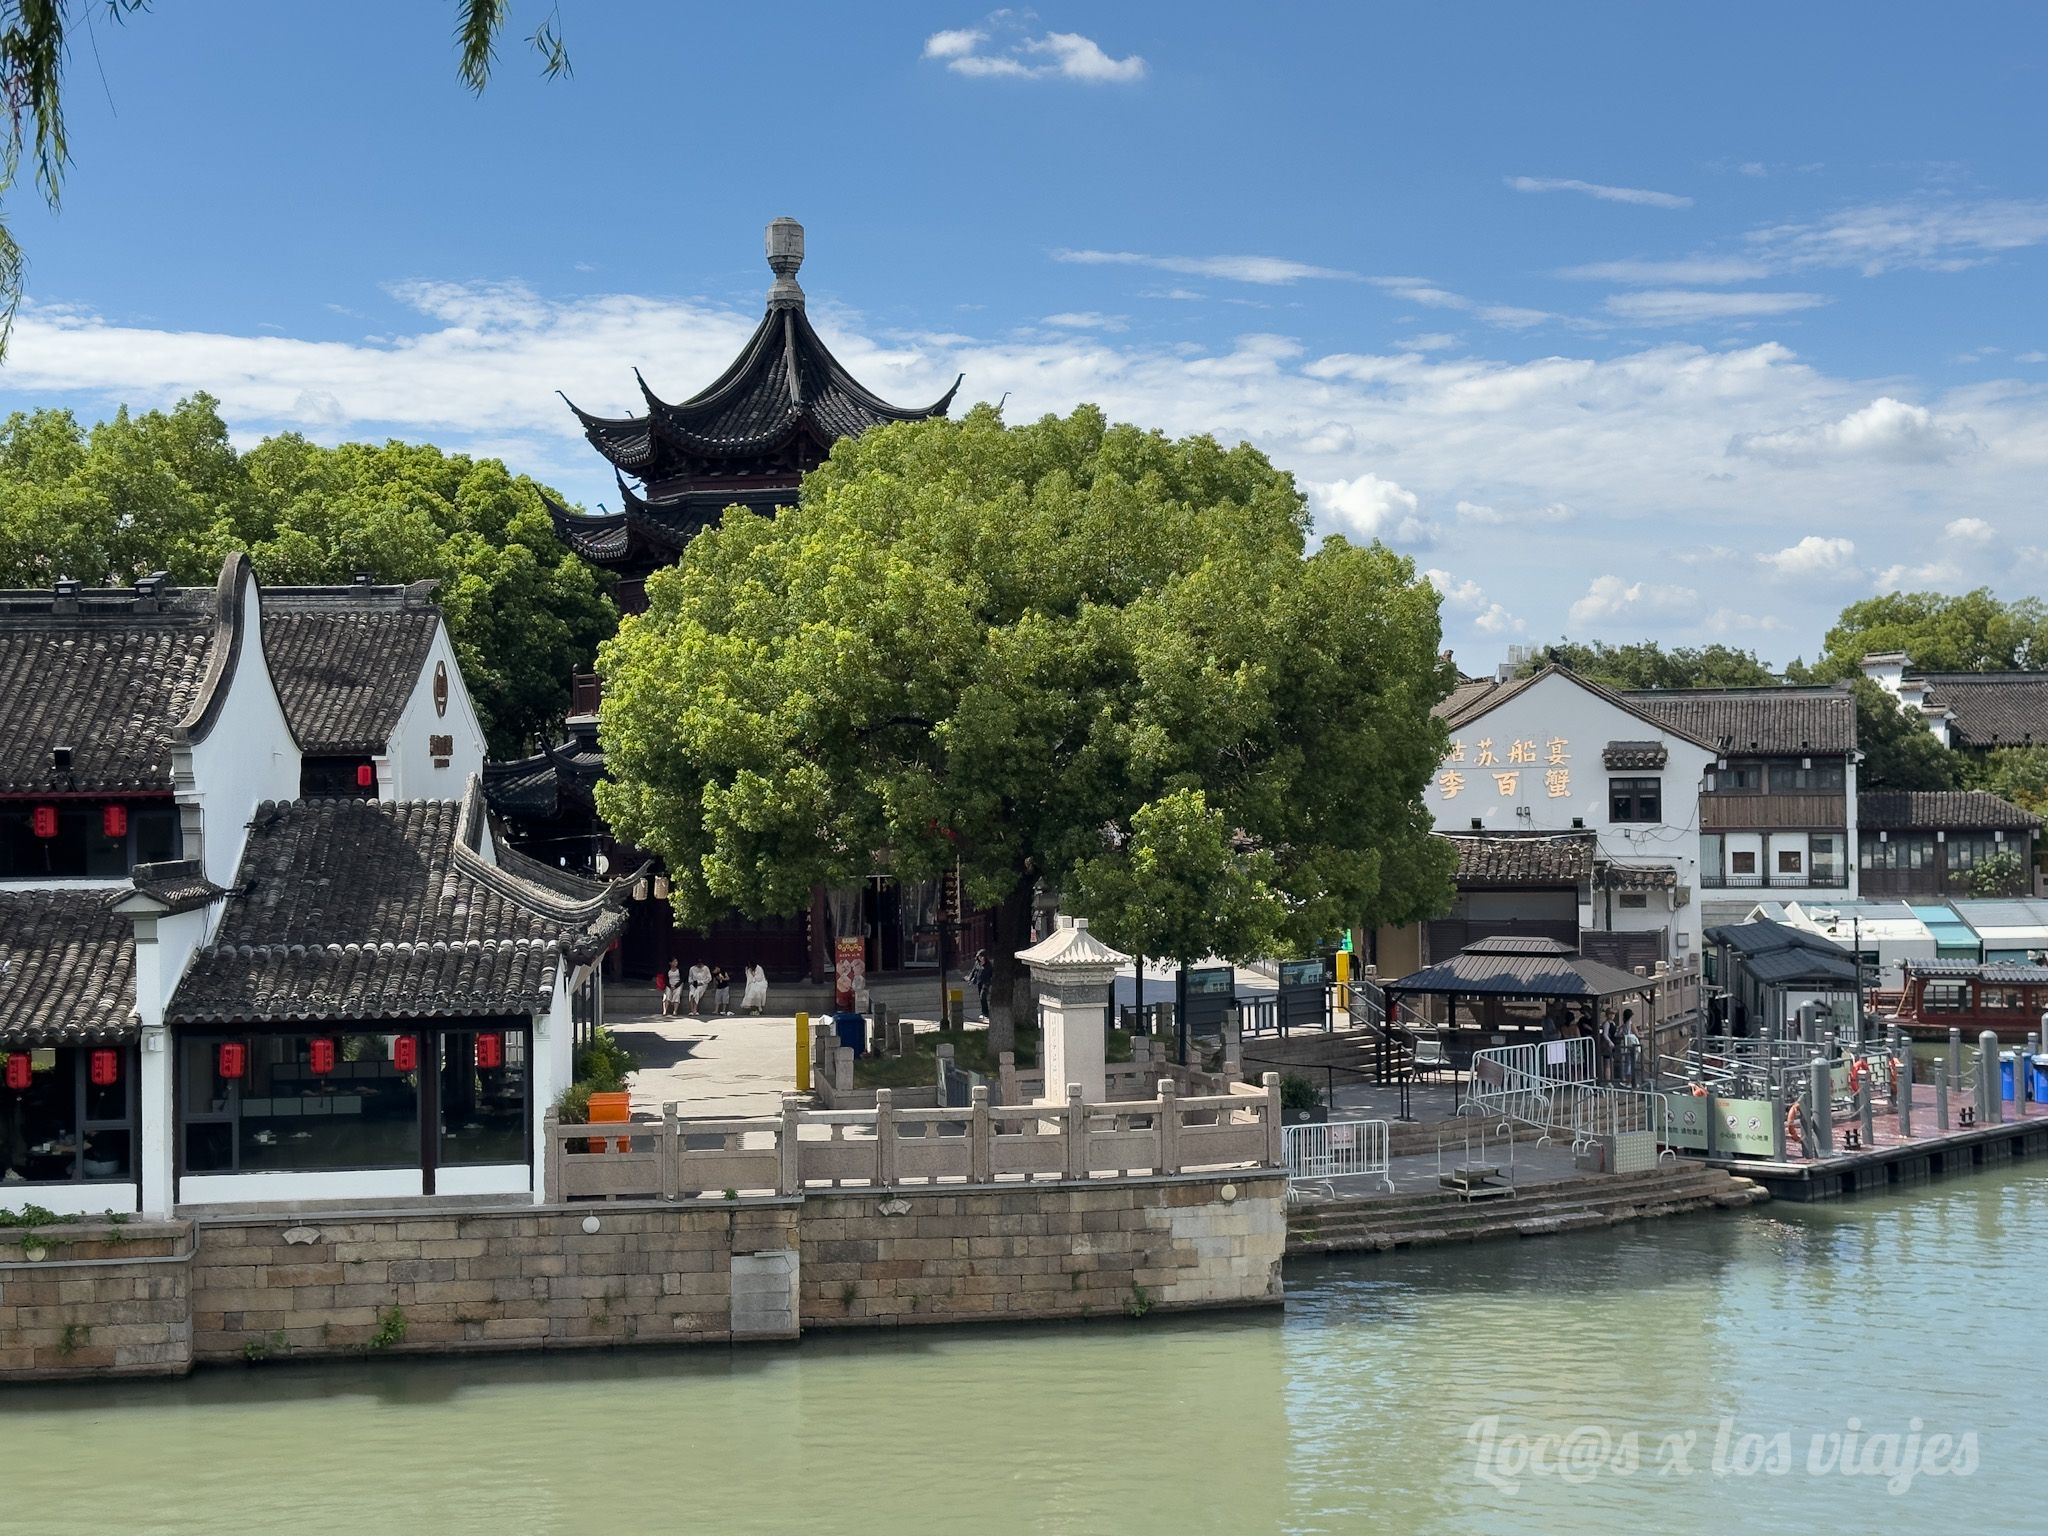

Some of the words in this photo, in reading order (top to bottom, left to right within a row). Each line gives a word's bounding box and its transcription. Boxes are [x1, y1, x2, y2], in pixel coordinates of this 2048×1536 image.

[1439, 736, 1572, 767] 姑苏船宴
[1439, 768, 1572, 800] 李百蟹
